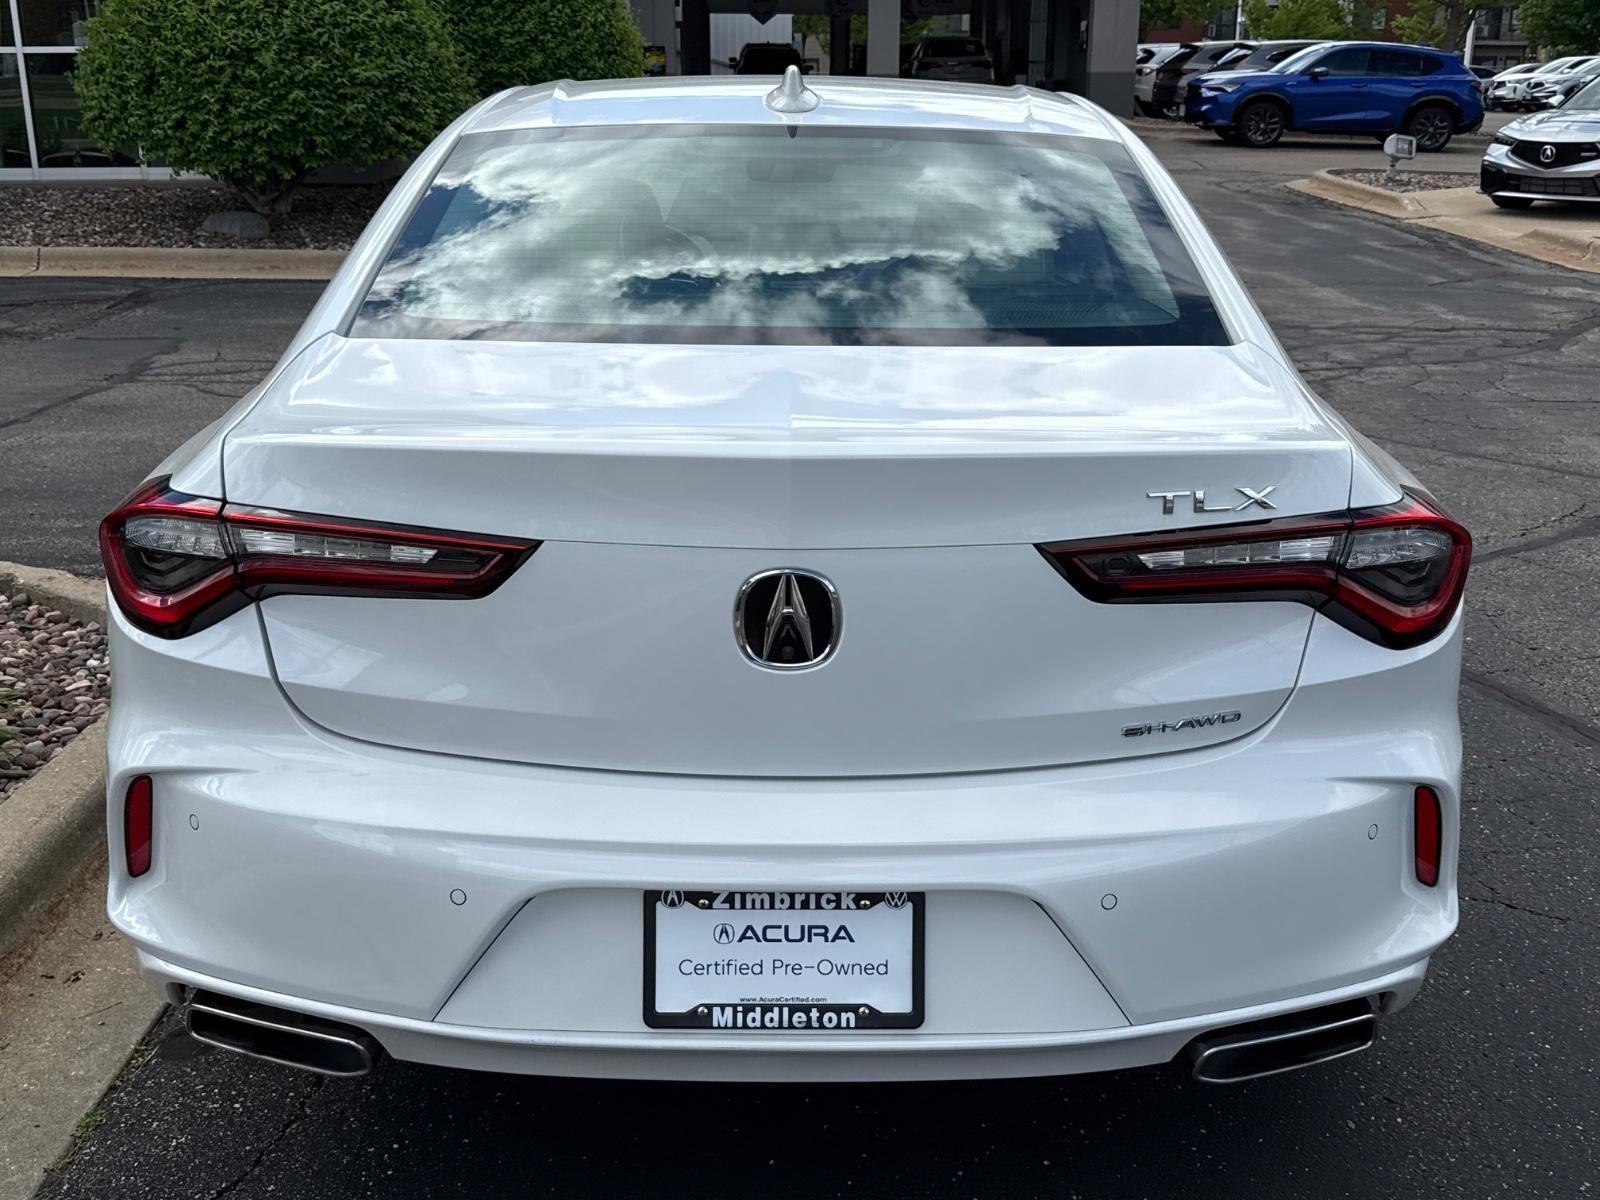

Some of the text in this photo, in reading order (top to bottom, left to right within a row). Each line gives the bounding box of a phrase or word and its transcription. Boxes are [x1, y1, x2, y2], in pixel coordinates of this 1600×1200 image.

[1147, 485, 1278, 515] TLX
[712, 891, 857, 909] Zimbrick
[737, 924, 855, 943] ACURA
[678, 959, 889, 976] Certified Pre-Owned
[739, 996, 827, 1004] www.AcuraCertified.com
[712, 1007, 856, 1028] Middleton
